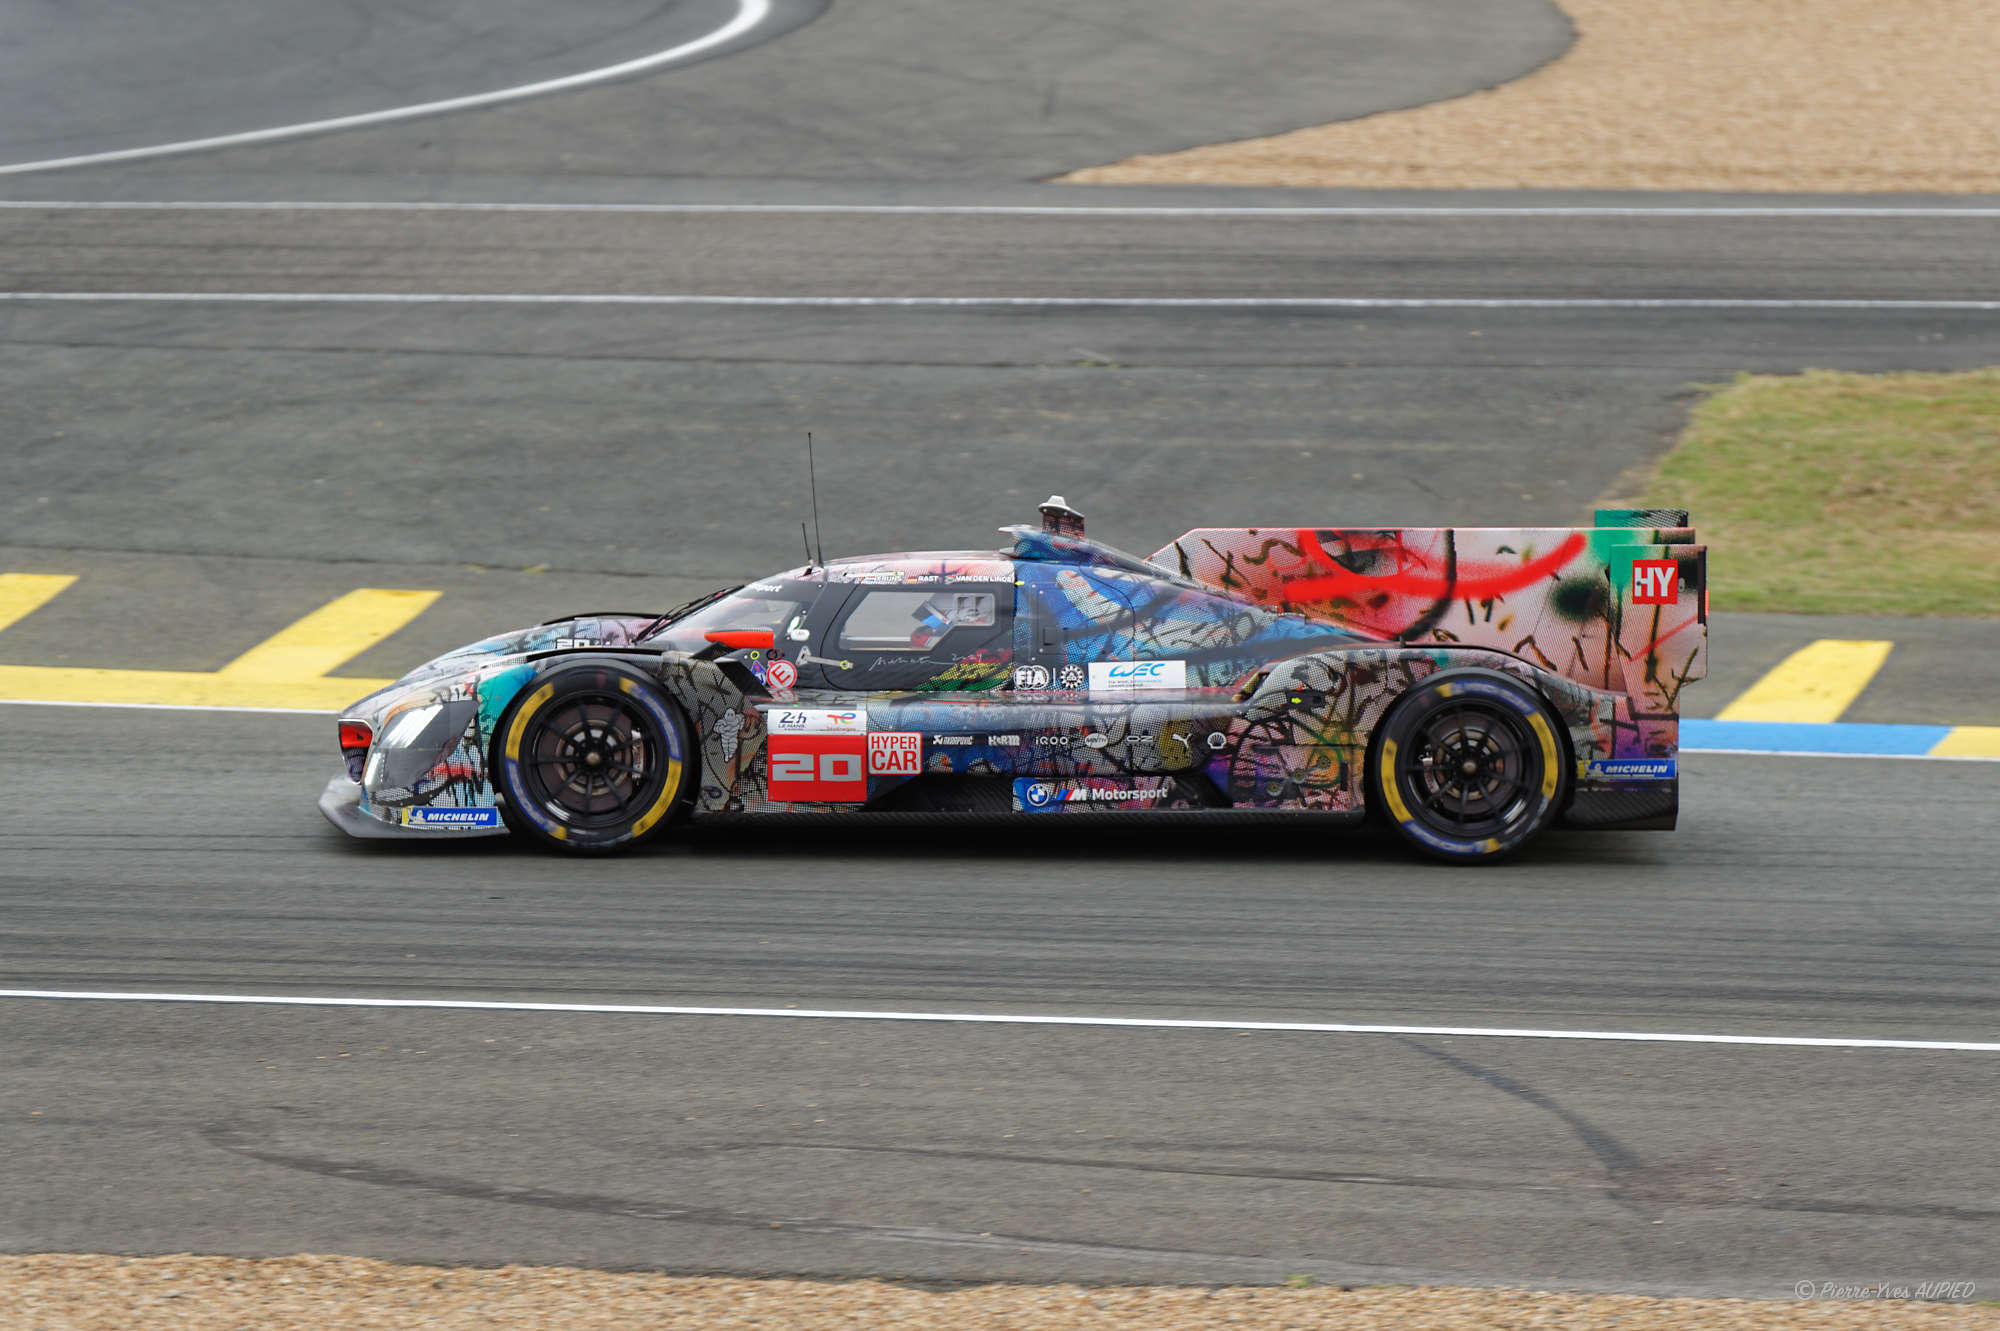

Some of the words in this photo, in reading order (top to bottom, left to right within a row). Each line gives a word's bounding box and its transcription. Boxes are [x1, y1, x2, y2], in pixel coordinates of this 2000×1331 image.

[1634, 567, 1675, 597] HY
[1109, 662, 1165, 677] WEC
[1016, 670, 1044, 684] FIA
[871, 735, 917, 750] HYPER
[1126, 735, 1154, 743] OZ
[772, 753, 862, 781] 20
[871, 750, 918, 771] CAR
[1605, 764, 1668, 773] MICHELIN
[1092, 787, 1168, 801] Motorsport
[427, 813, 489, 821] MICHELIN
